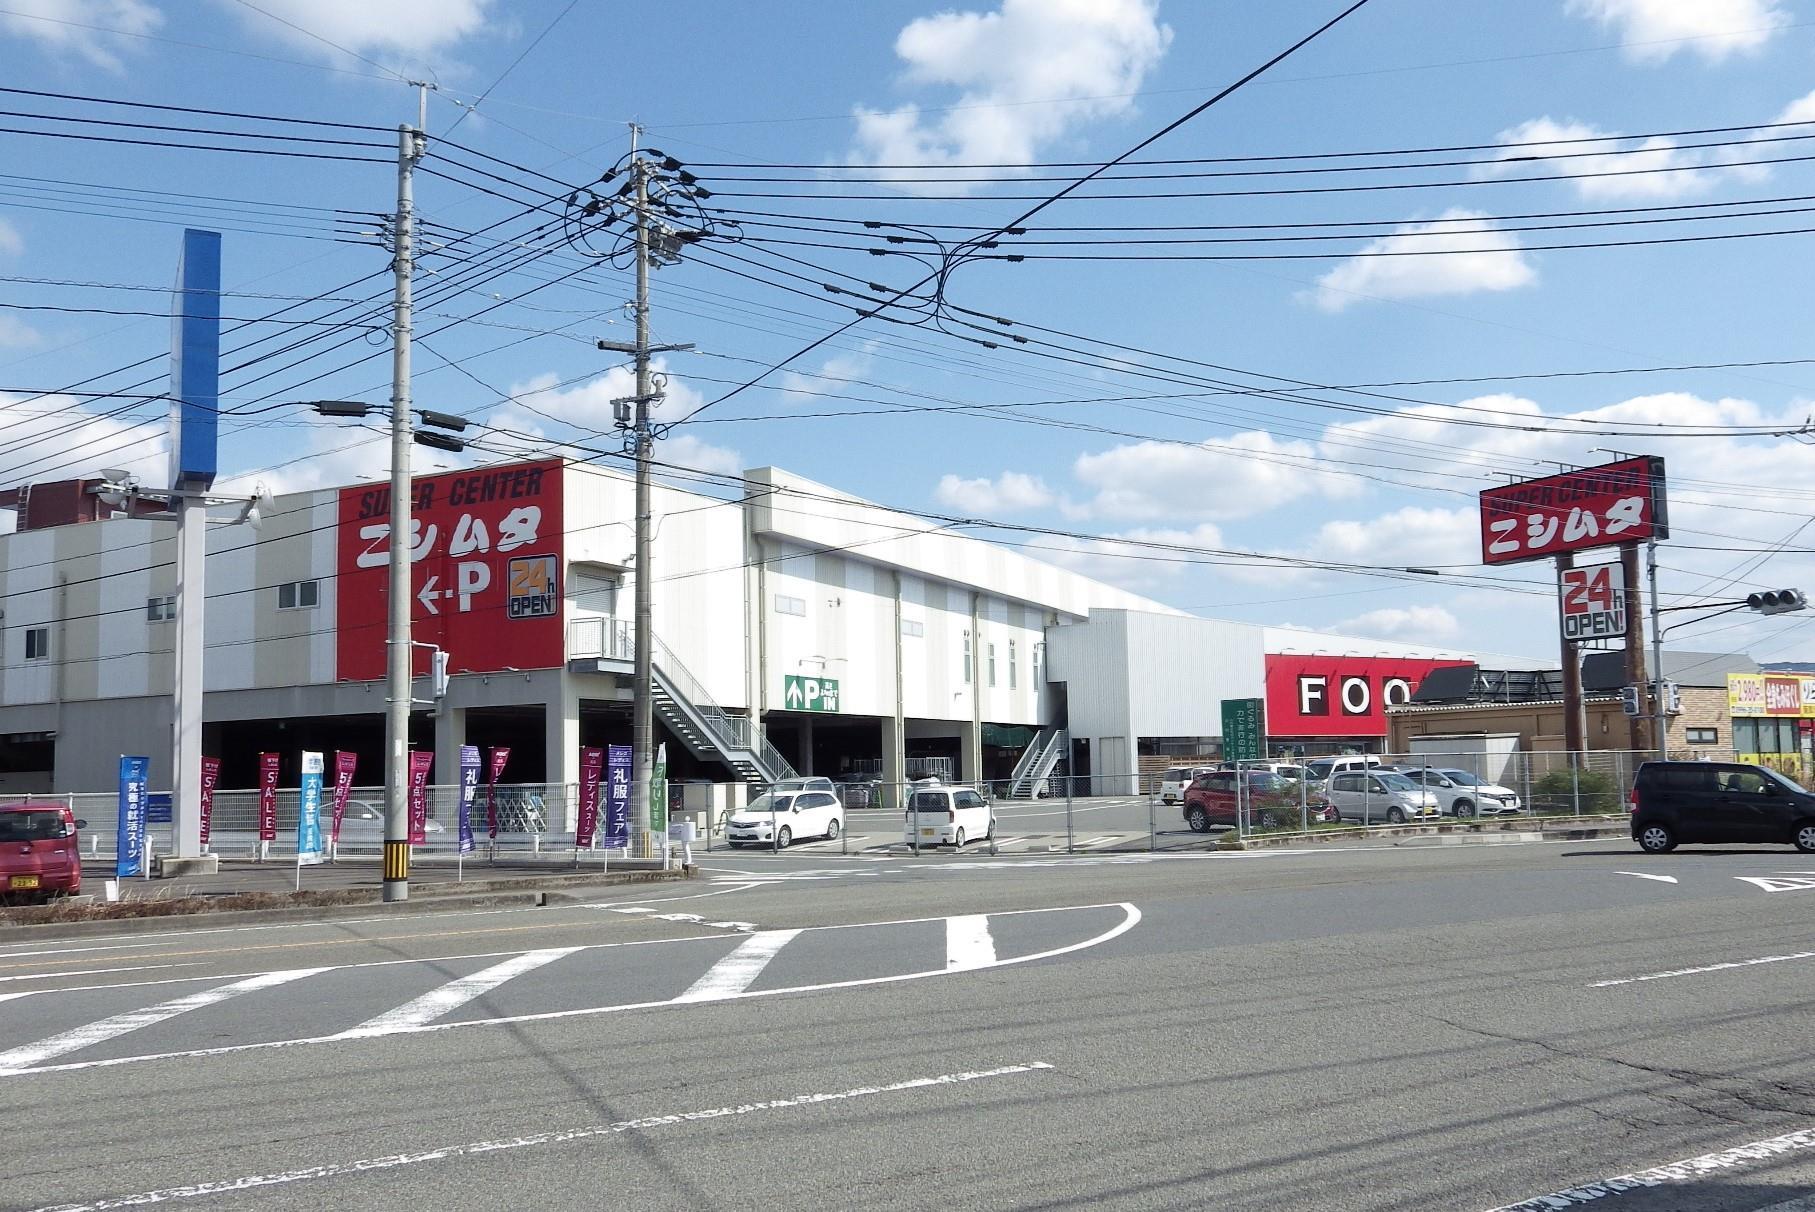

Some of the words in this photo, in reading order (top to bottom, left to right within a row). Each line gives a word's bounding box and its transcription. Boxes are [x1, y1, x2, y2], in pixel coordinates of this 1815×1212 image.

[359, 482, 435, 518] SUER
[449, 467, 543, 506] CENTER
[1558, 466, 1641, 504] CENTER
[356, 505, 541, 568] ニシムタ
[1488, 496, 1644, 554] ニシムタ
[458, 561, 490, 612] P
[1565, 611, 1624, 636] OPEN!
[804, 679, 820, 709] P
[823, 696, 836, 711] IN
[201, 776, 212, 832] SALE
[264, 771, 274, 829] SALE
[583, 768, 597, 834] レディススーツ
[612, 768, 628, 835] 礼服フェア
